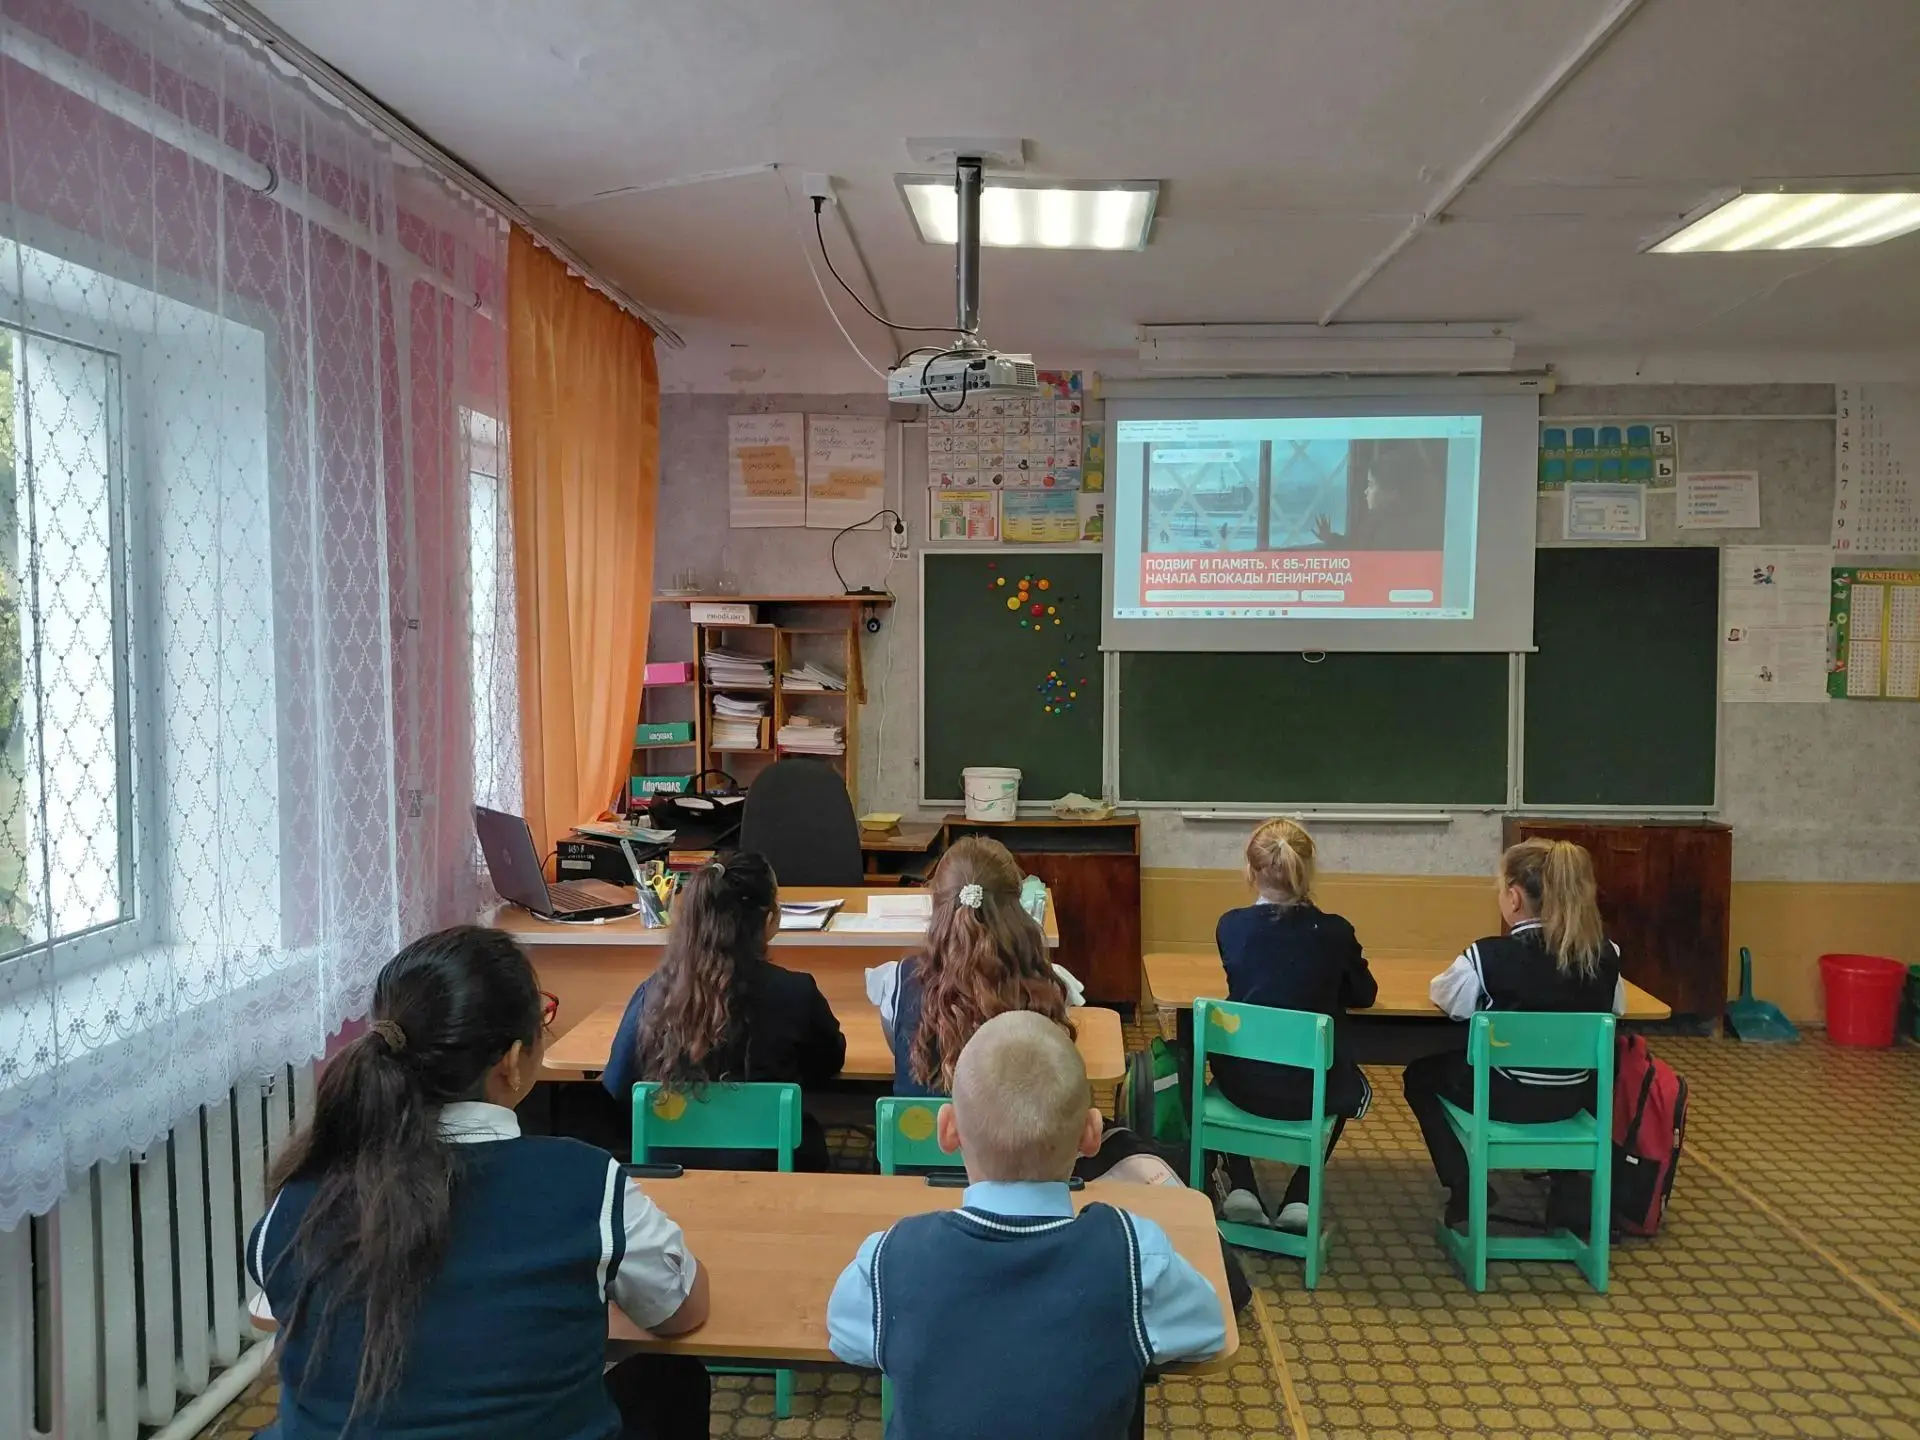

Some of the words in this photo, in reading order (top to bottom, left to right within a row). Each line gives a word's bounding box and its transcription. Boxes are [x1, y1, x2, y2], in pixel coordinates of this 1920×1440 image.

[1842, 408, 1849, 419] 3
[1656, 430, 1672, 444] Ъ
[1842, 442, 1849, 452] 5
[1841, 479, 1849, 490] 7
[1840, 499, 1847, 511] 8
[1838, 518, 1845, 529] 9
[1836, 538, 1850, 549] 10
[1146, 559, 1197, 571] ПОДВИГ
[1200, 559, 1209, 569] И
[1212, 559, 1268, 570] ПАМЯТЬ.
[1272, 559, 1280, 569] К
[1283, 558, 1351, 569] 85-ЛЕТИЮ
[1145, 573, 1197, 584] НАЧАЛА
[1200, 573, 1263, 585] БЛОКАДЫ
[1266, 572, 1353, 585] ЛЕНИНГРАДА
[1858, 571, 1913, 581] ТАБЛИЦА
